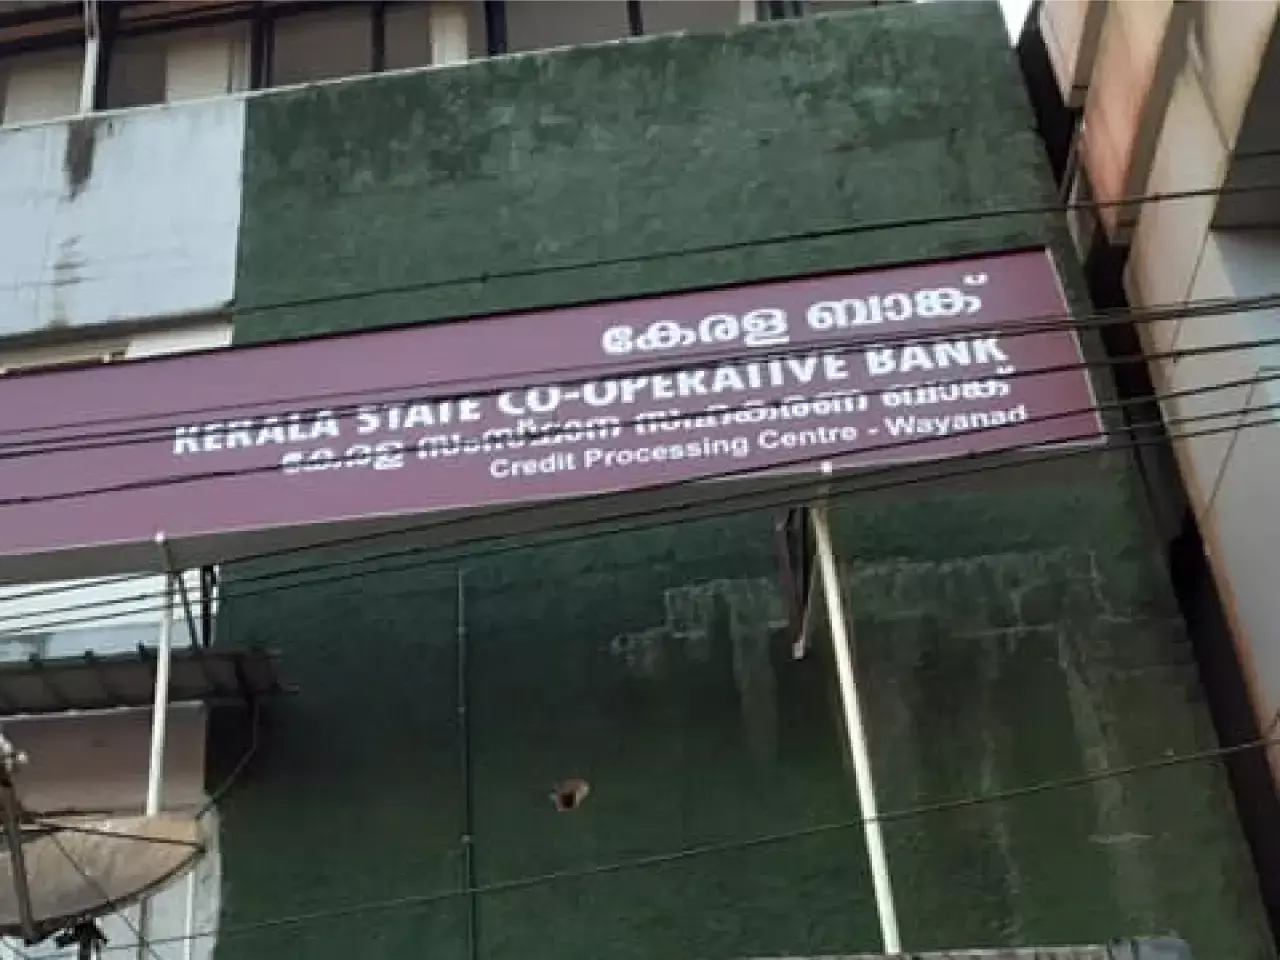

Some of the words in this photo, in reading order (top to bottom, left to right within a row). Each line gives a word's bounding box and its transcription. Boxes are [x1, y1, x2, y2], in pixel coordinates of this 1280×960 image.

[602, 307, 789, 355] കേരള
[806, 272, 989, 328] ബാങ്ക്
[864, 330, 1009, 376] BANK
[490, 451, 577, 478] Credit
[583, 436, 750, 470] Processing
[757, 425, 858, 449] Centre
[884, 404, 1028, 437] Wayanad
